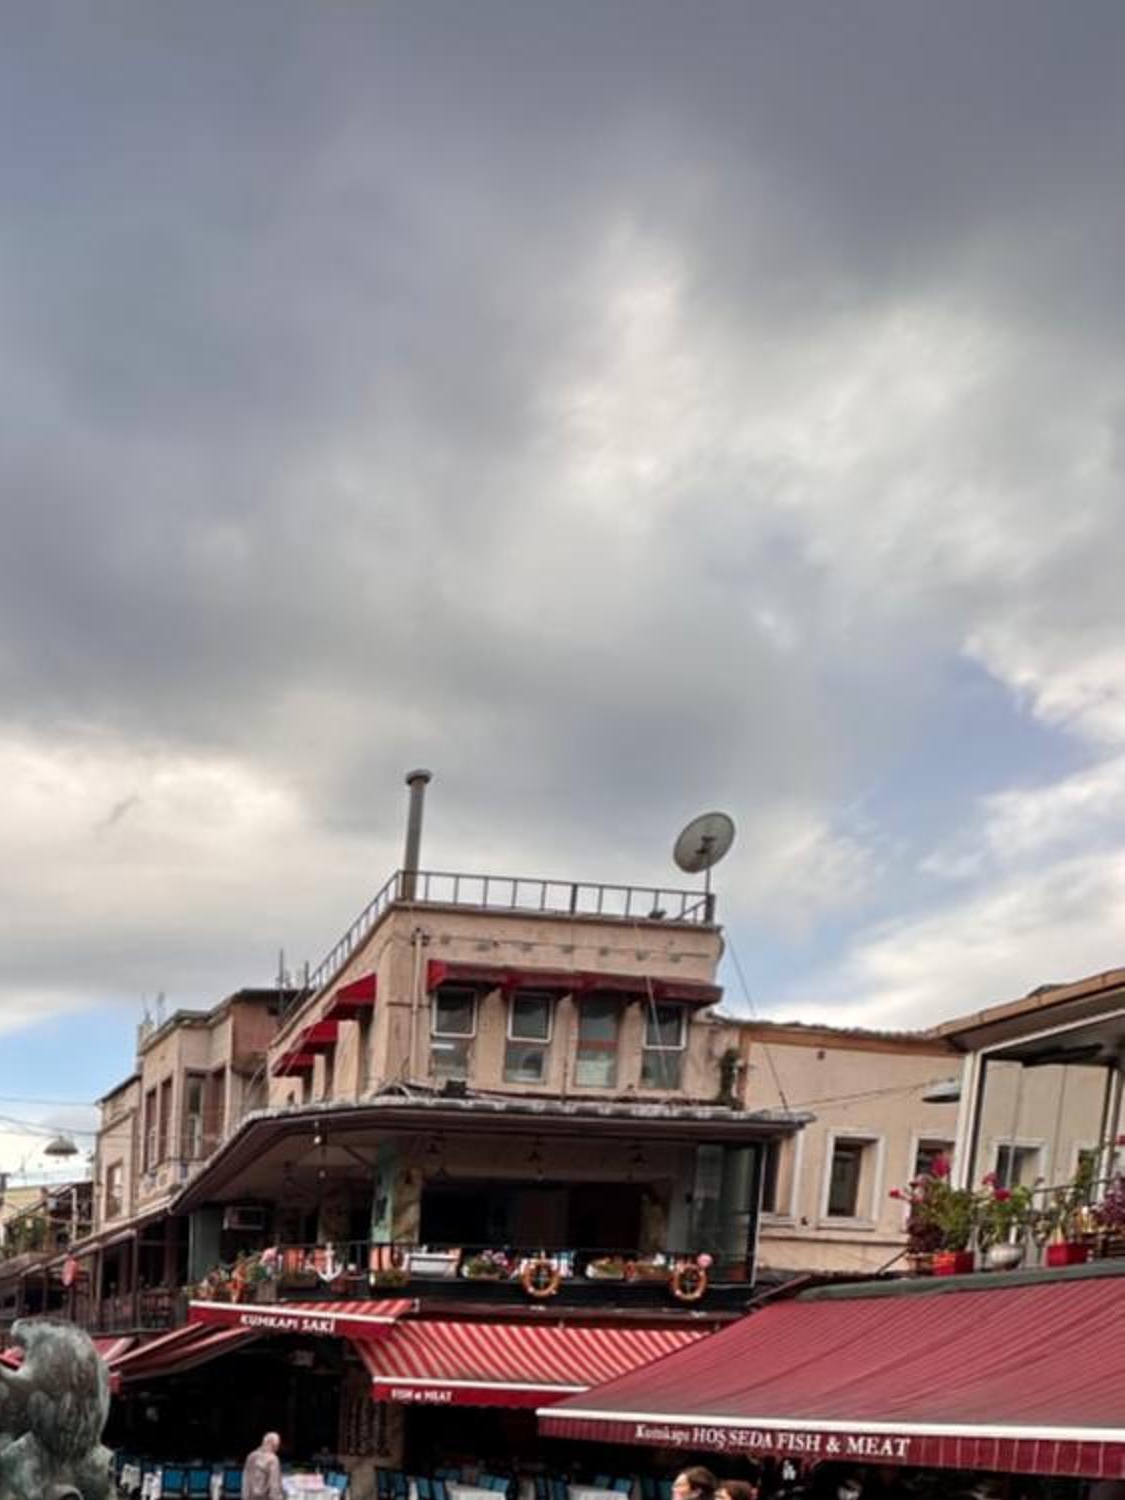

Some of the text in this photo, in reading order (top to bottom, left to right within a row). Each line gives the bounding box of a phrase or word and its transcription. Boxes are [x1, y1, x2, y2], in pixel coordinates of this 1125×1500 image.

[240, 1315, 299, 1329] KUMKAPI
[424, 1390, 452, 1402] MEAT
[777, 1432, 821, 1452] FISH
[826, 1435, 841, 1454] &
[846, 1436, 912, 1457] MEAT
